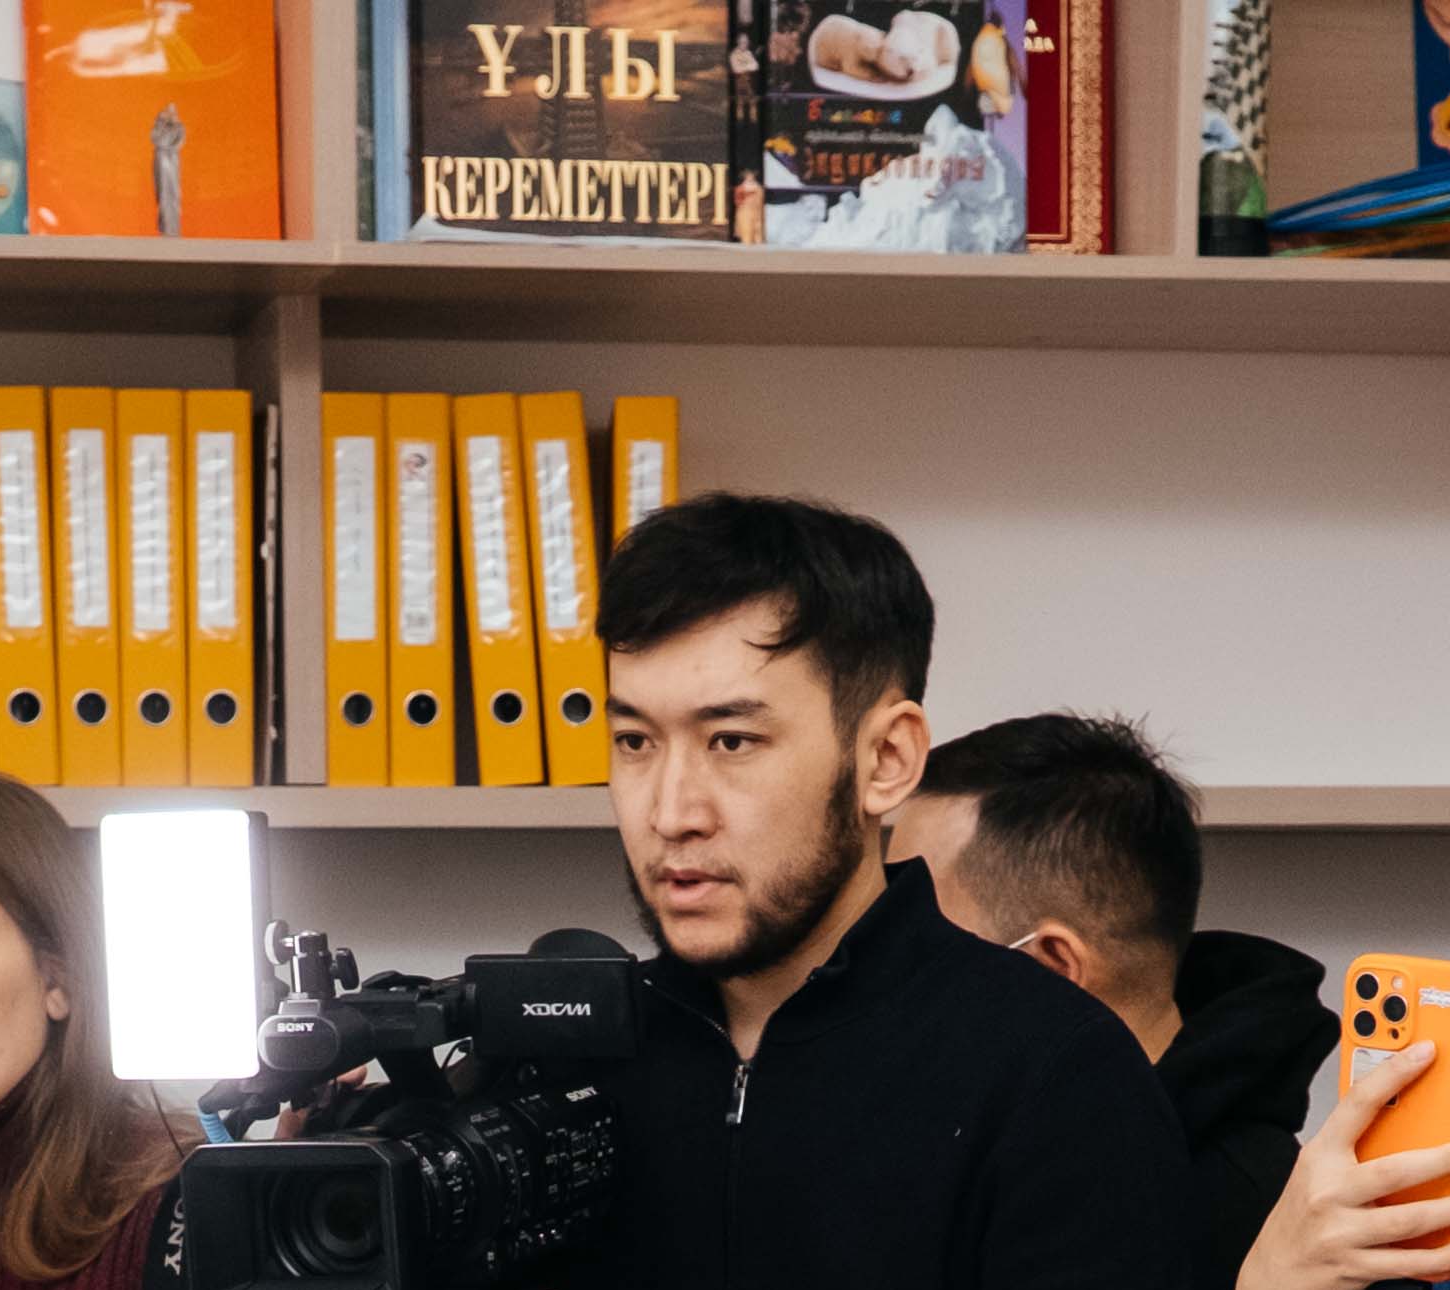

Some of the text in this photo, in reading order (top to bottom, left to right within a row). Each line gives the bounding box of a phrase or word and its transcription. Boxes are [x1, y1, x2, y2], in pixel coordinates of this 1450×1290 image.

[467, 24, 680, 101] ҰЛЫ
[421, 155, 729, 225] КЕРЕМЕТТЕРІ
[277, 1021, 315, 1033] SONY
[521, 1002, 592, 1017] XDCAM
[163, 1197, 185, 1277] ONY
